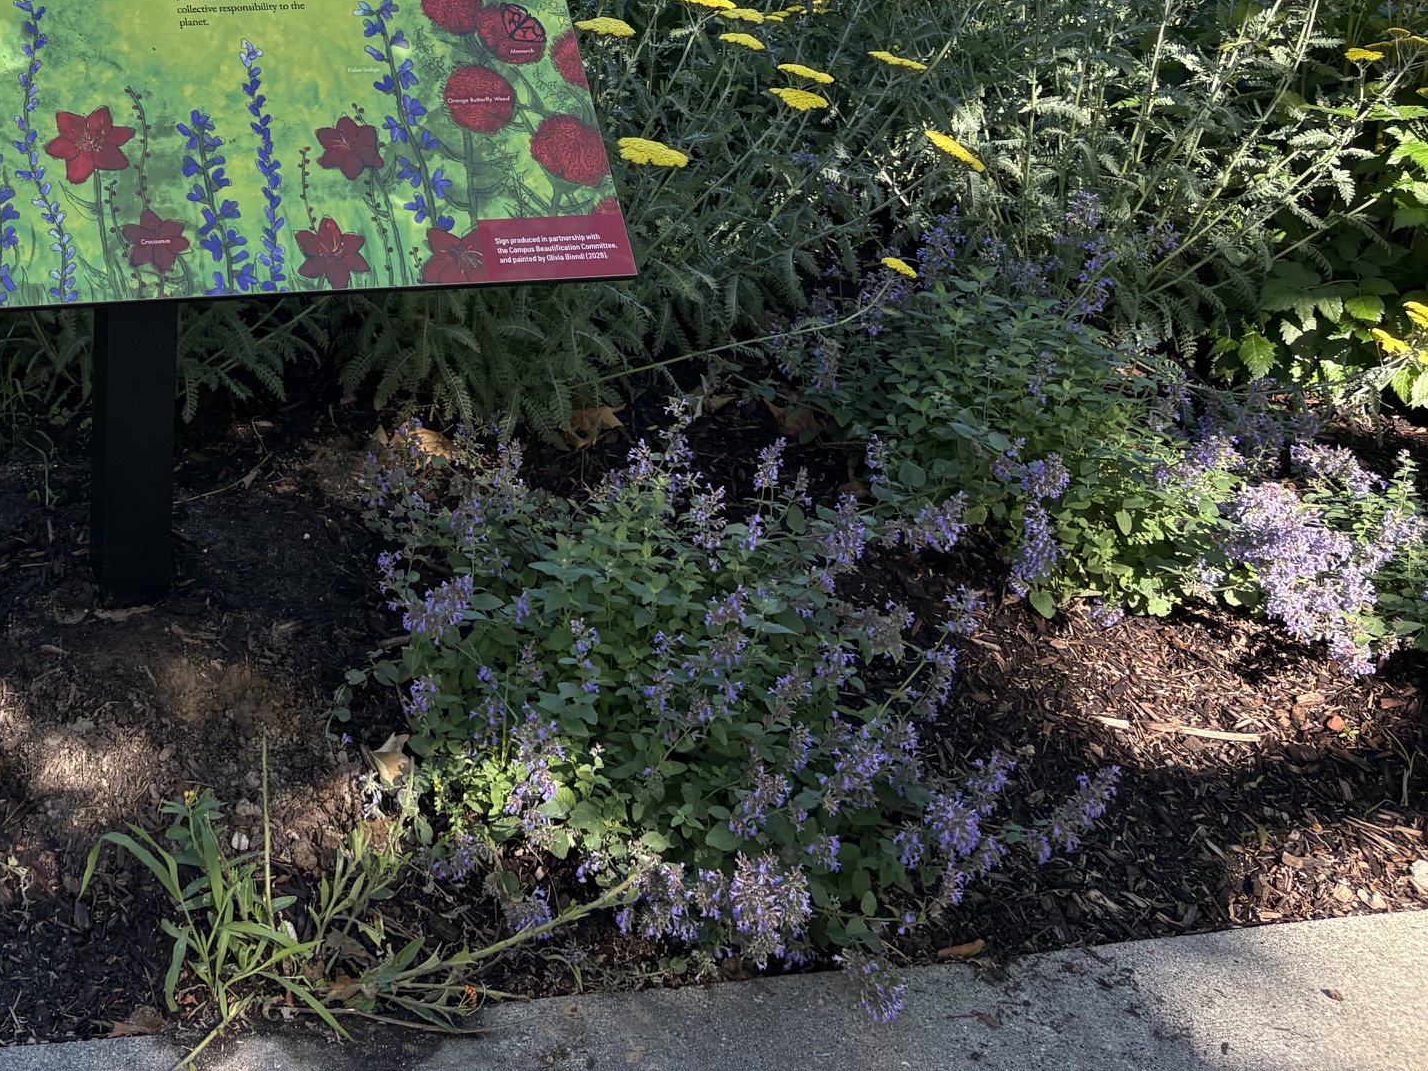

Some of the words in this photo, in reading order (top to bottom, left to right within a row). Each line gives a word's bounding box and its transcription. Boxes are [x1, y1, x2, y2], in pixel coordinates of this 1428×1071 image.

[176, 4, 217, 14] collective
[218, 1, 278, 14] responsibility
[278, 2, 289, 10] to
[290, 0, 305, 9] the
[178, 17, 209, 29] planet.
[510, 237, 540, 245] produced
[536, 244, 580, 252] Beautification
[513, 256, 537, 264] painted
